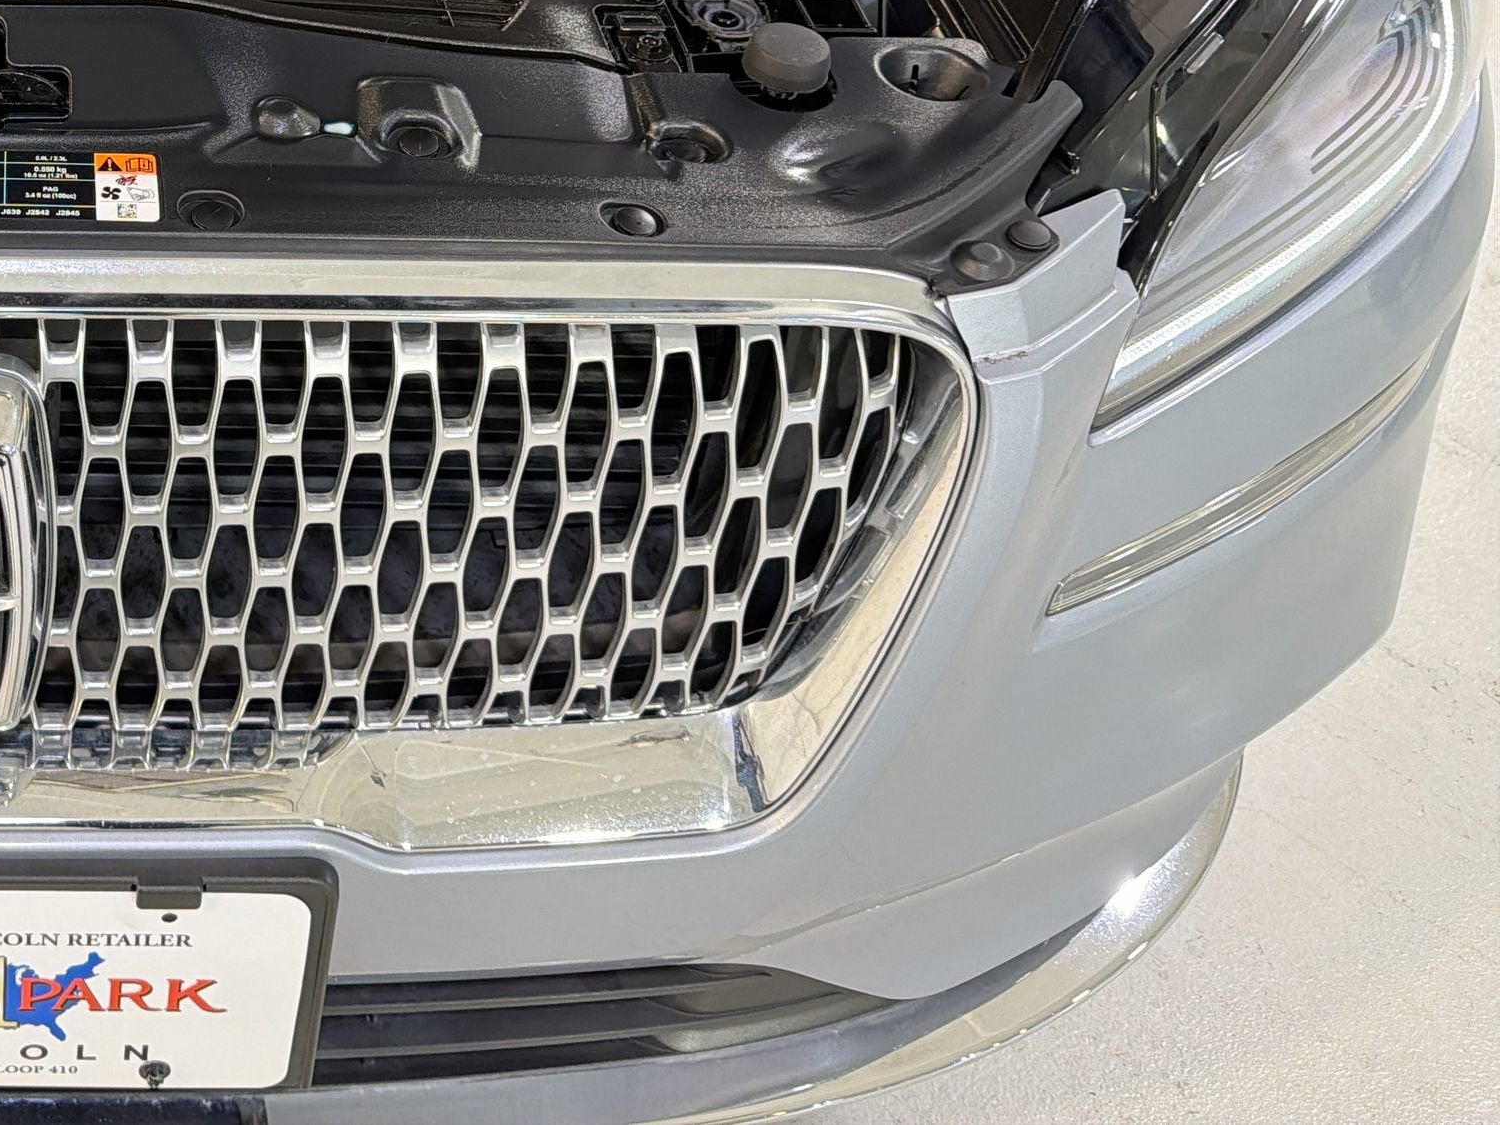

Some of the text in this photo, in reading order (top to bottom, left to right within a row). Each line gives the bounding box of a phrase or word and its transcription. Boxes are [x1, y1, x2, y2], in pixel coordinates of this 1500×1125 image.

[67, 932, 193, 947] RETAILER
[18, 978, 228, 1013] PARK
[48, 1065, 78, 1074] 410
